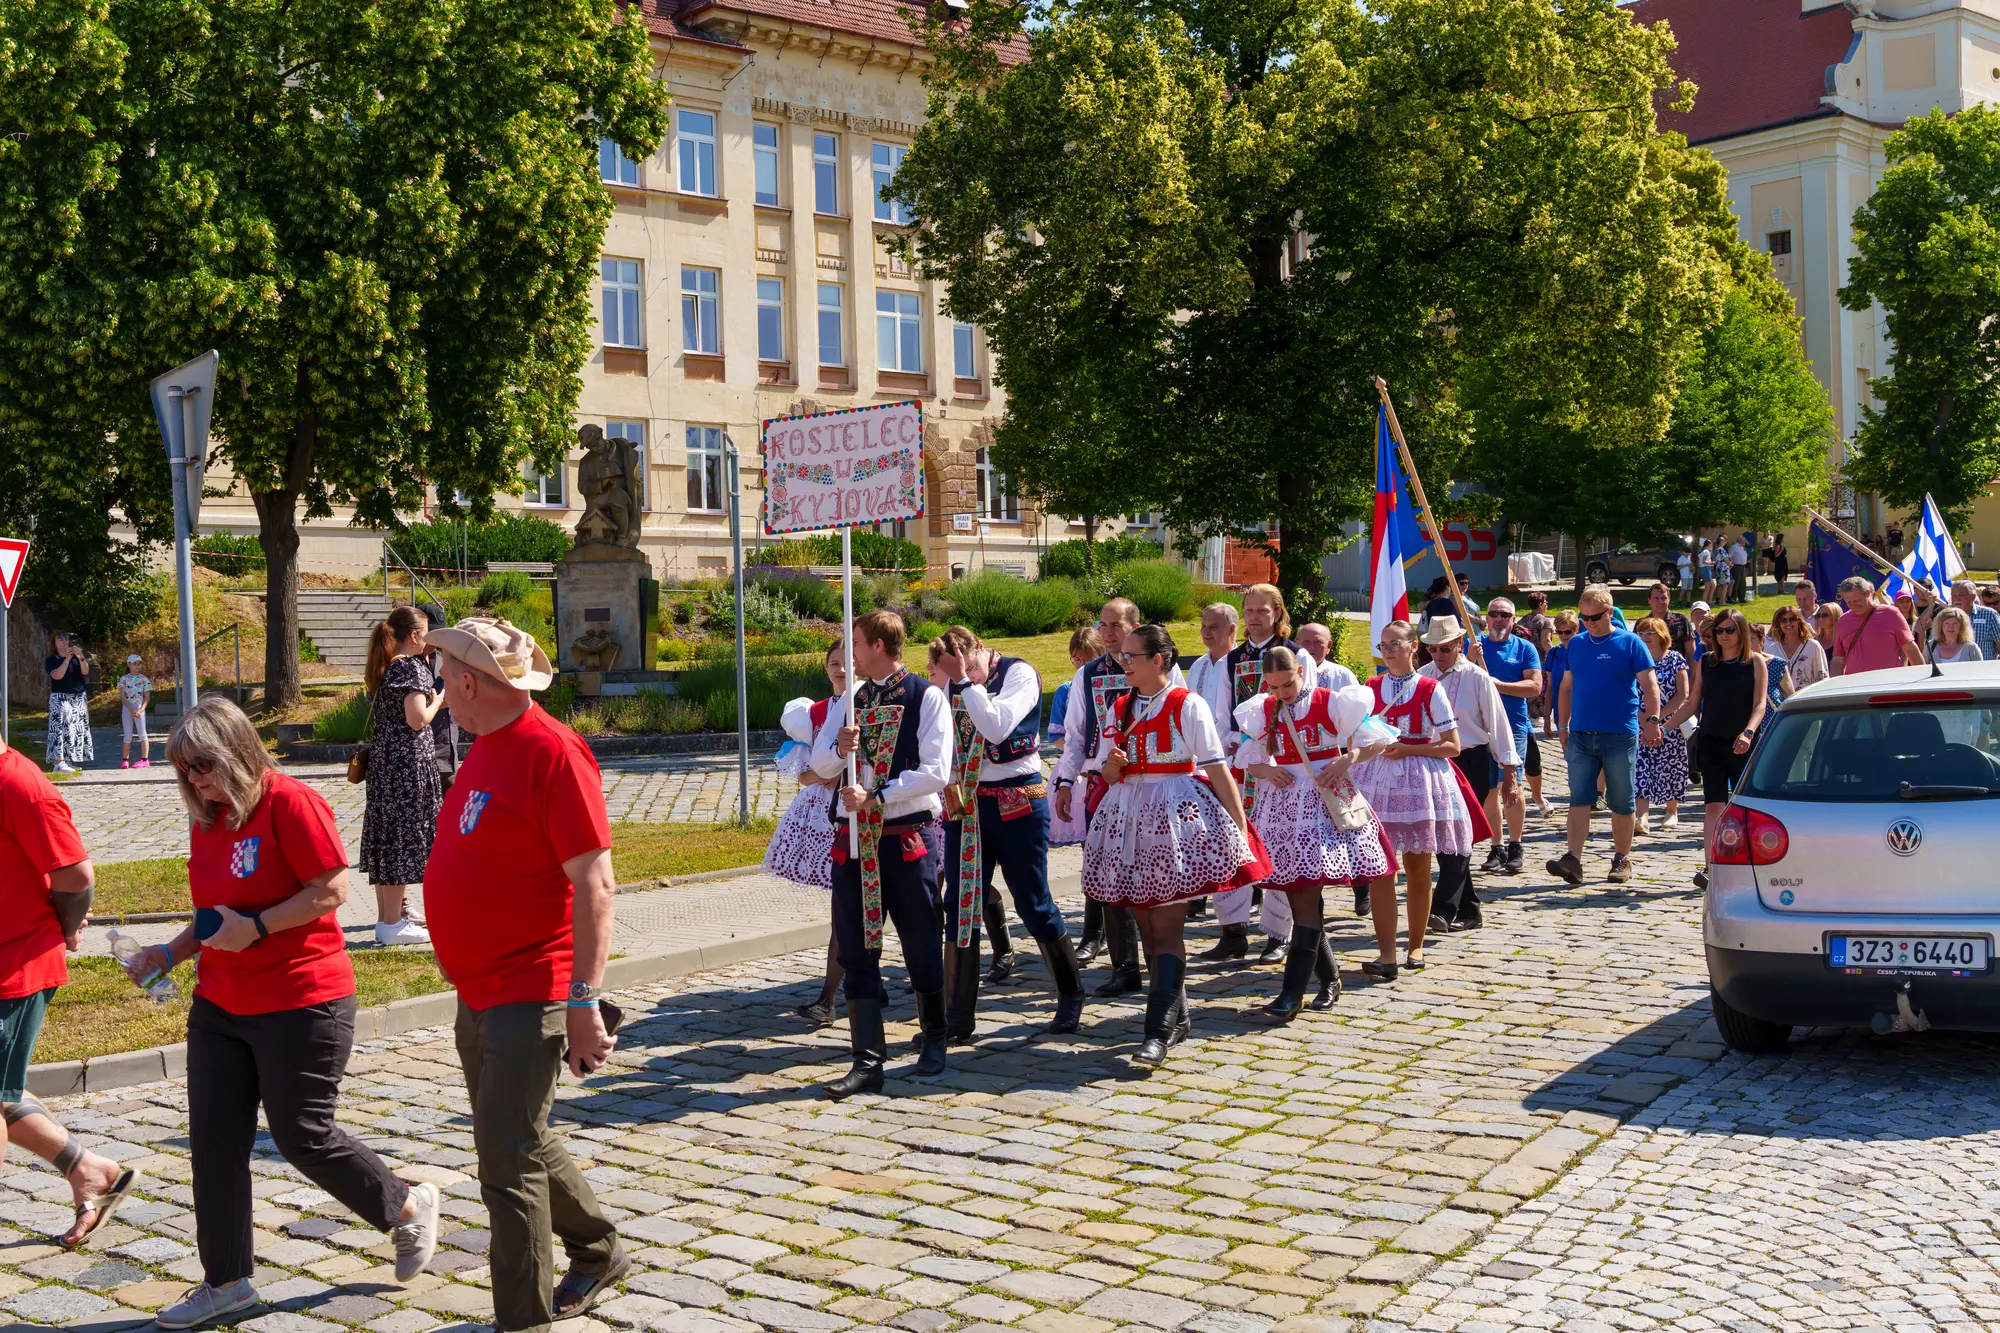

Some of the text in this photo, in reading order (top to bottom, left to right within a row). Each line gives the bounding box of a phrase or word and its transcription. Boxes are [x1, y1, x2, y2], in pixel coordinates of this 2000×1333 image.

[769, 415, 915, 460] KOSTELEC
[833, 458, 853, 478] U
[788, 484, 898, 525] KYJOVA
[1768, 877, 1804, 887] GOLF
[1833, 955, 1845, 963] CZ
[1851, 940, 1974, 965] 3Z3 6440
